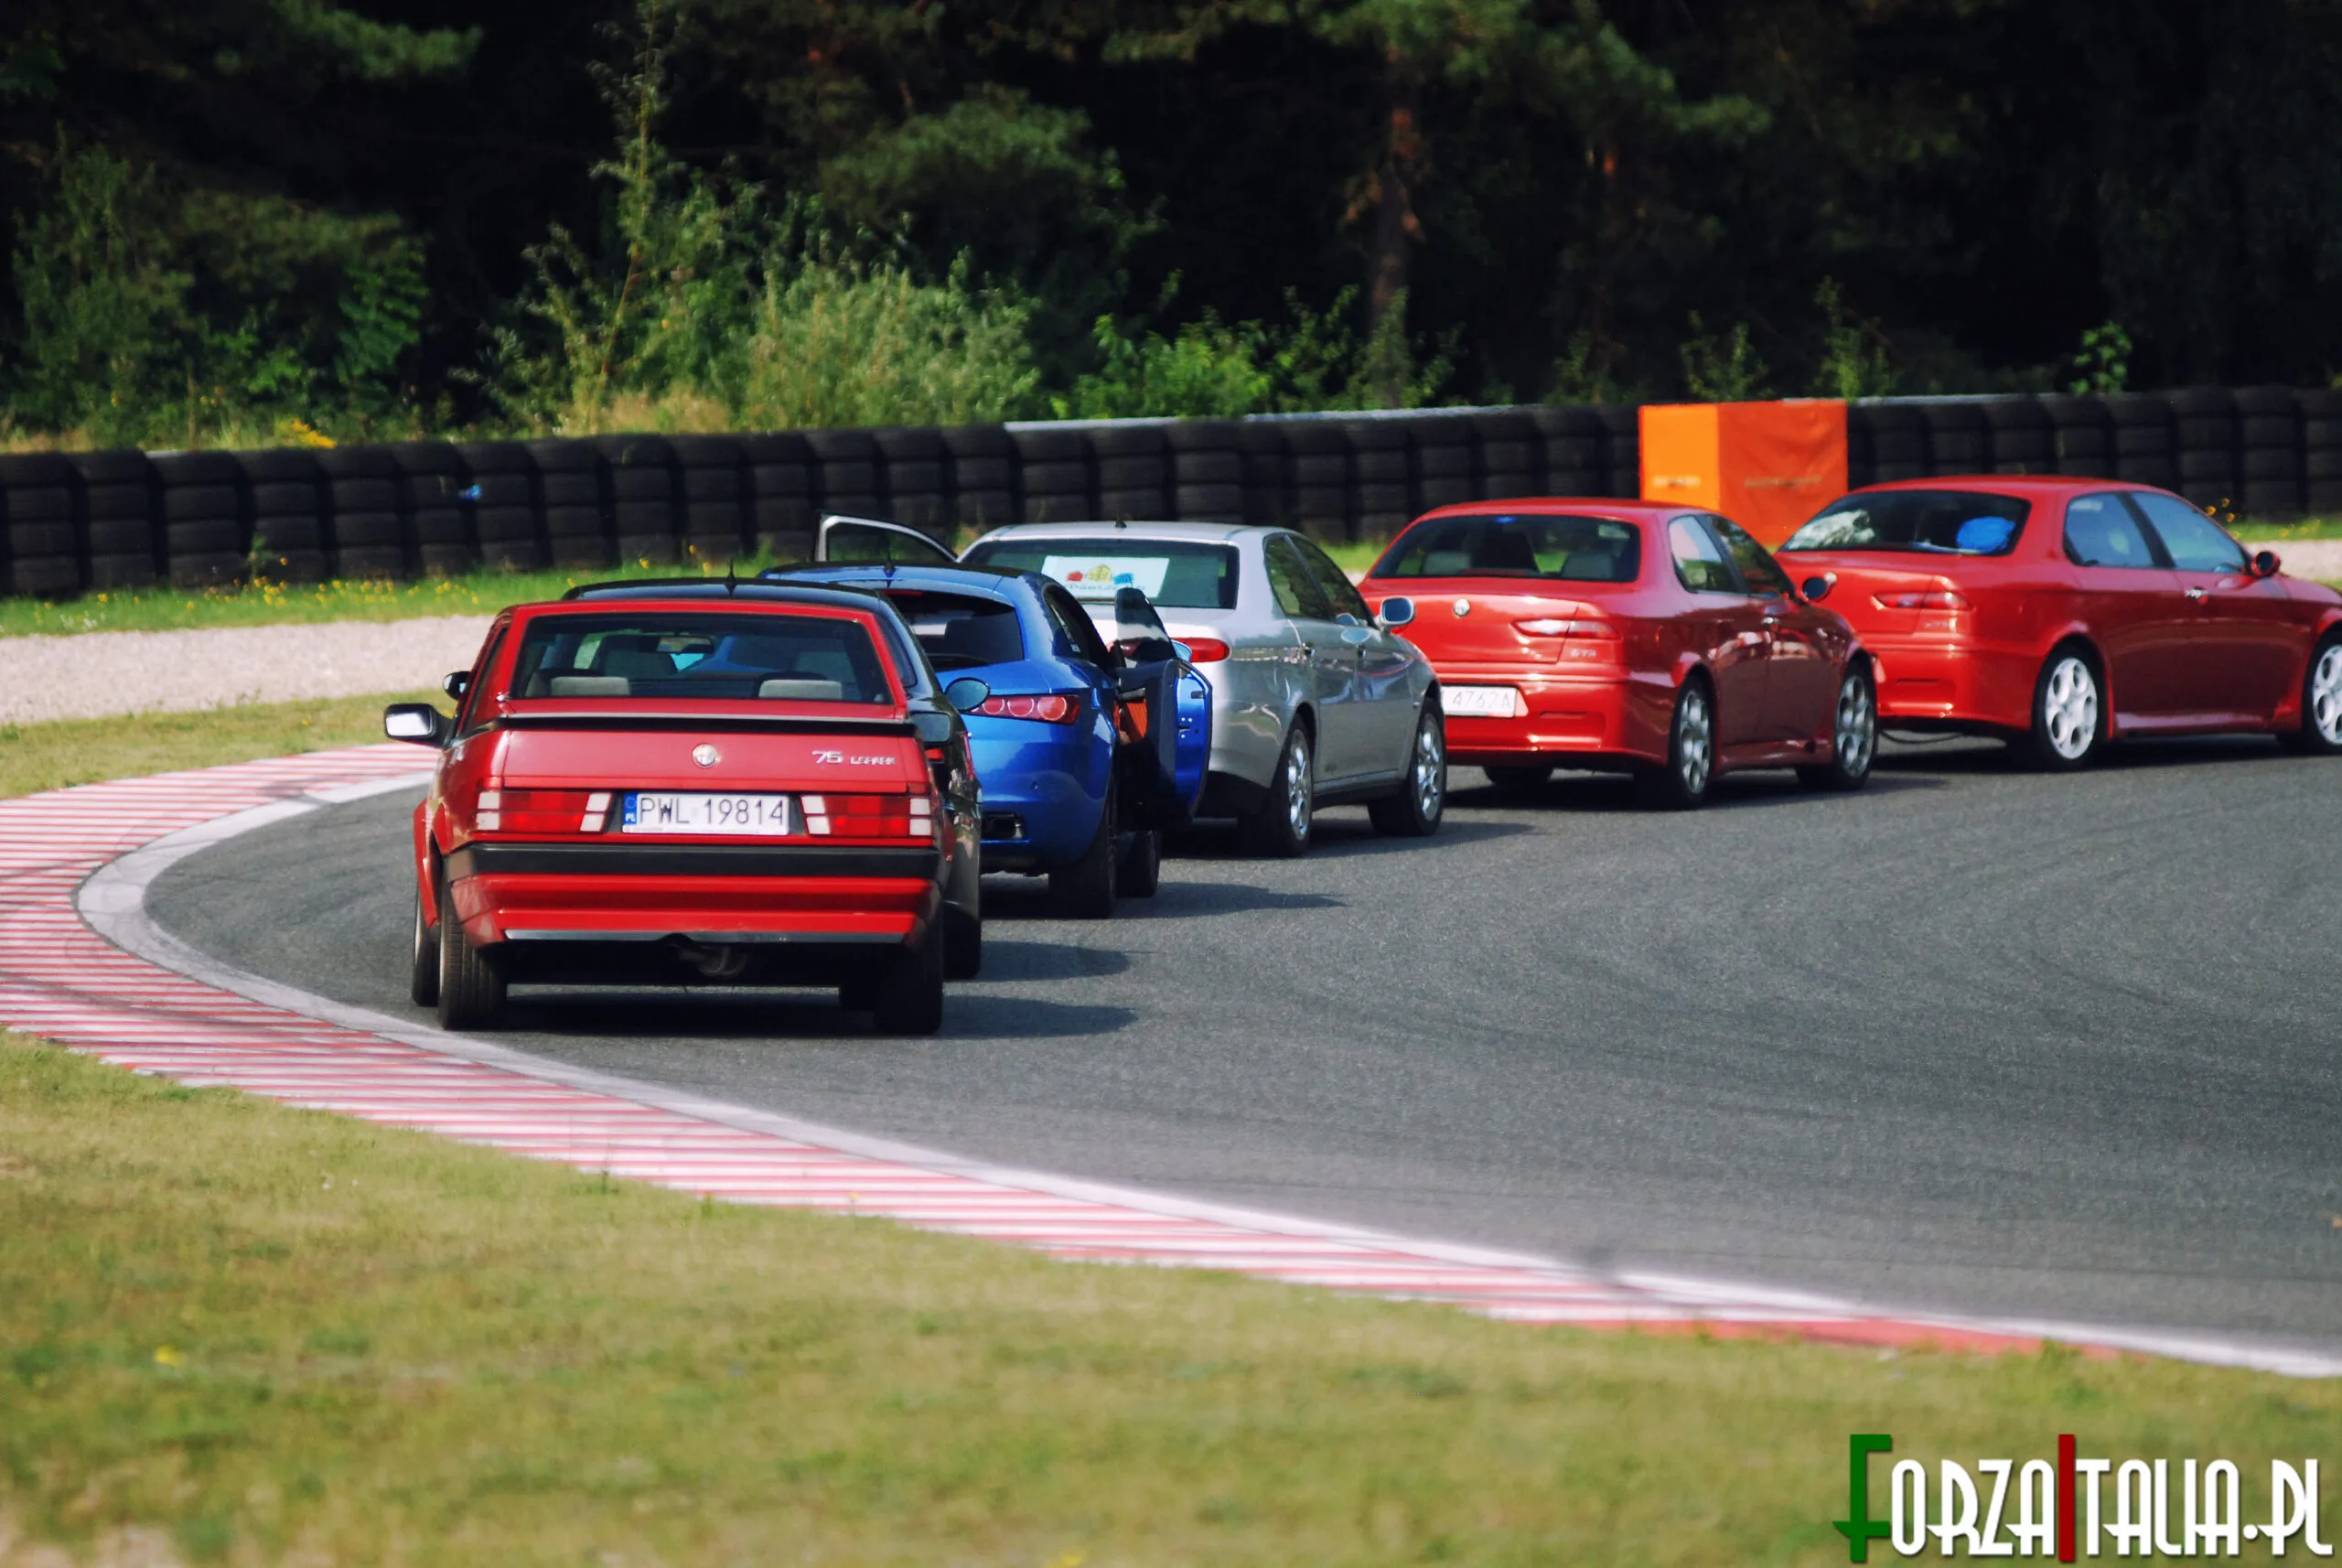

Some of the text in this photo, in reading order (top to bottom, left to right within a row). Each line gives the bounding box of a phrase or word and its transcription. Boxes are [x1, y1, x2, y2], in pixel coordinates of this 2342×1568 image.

[811, 750, 843, 764] 75
[625, 812, 637, 822] PL
[639, 797, 783, 825] PWL 19814
